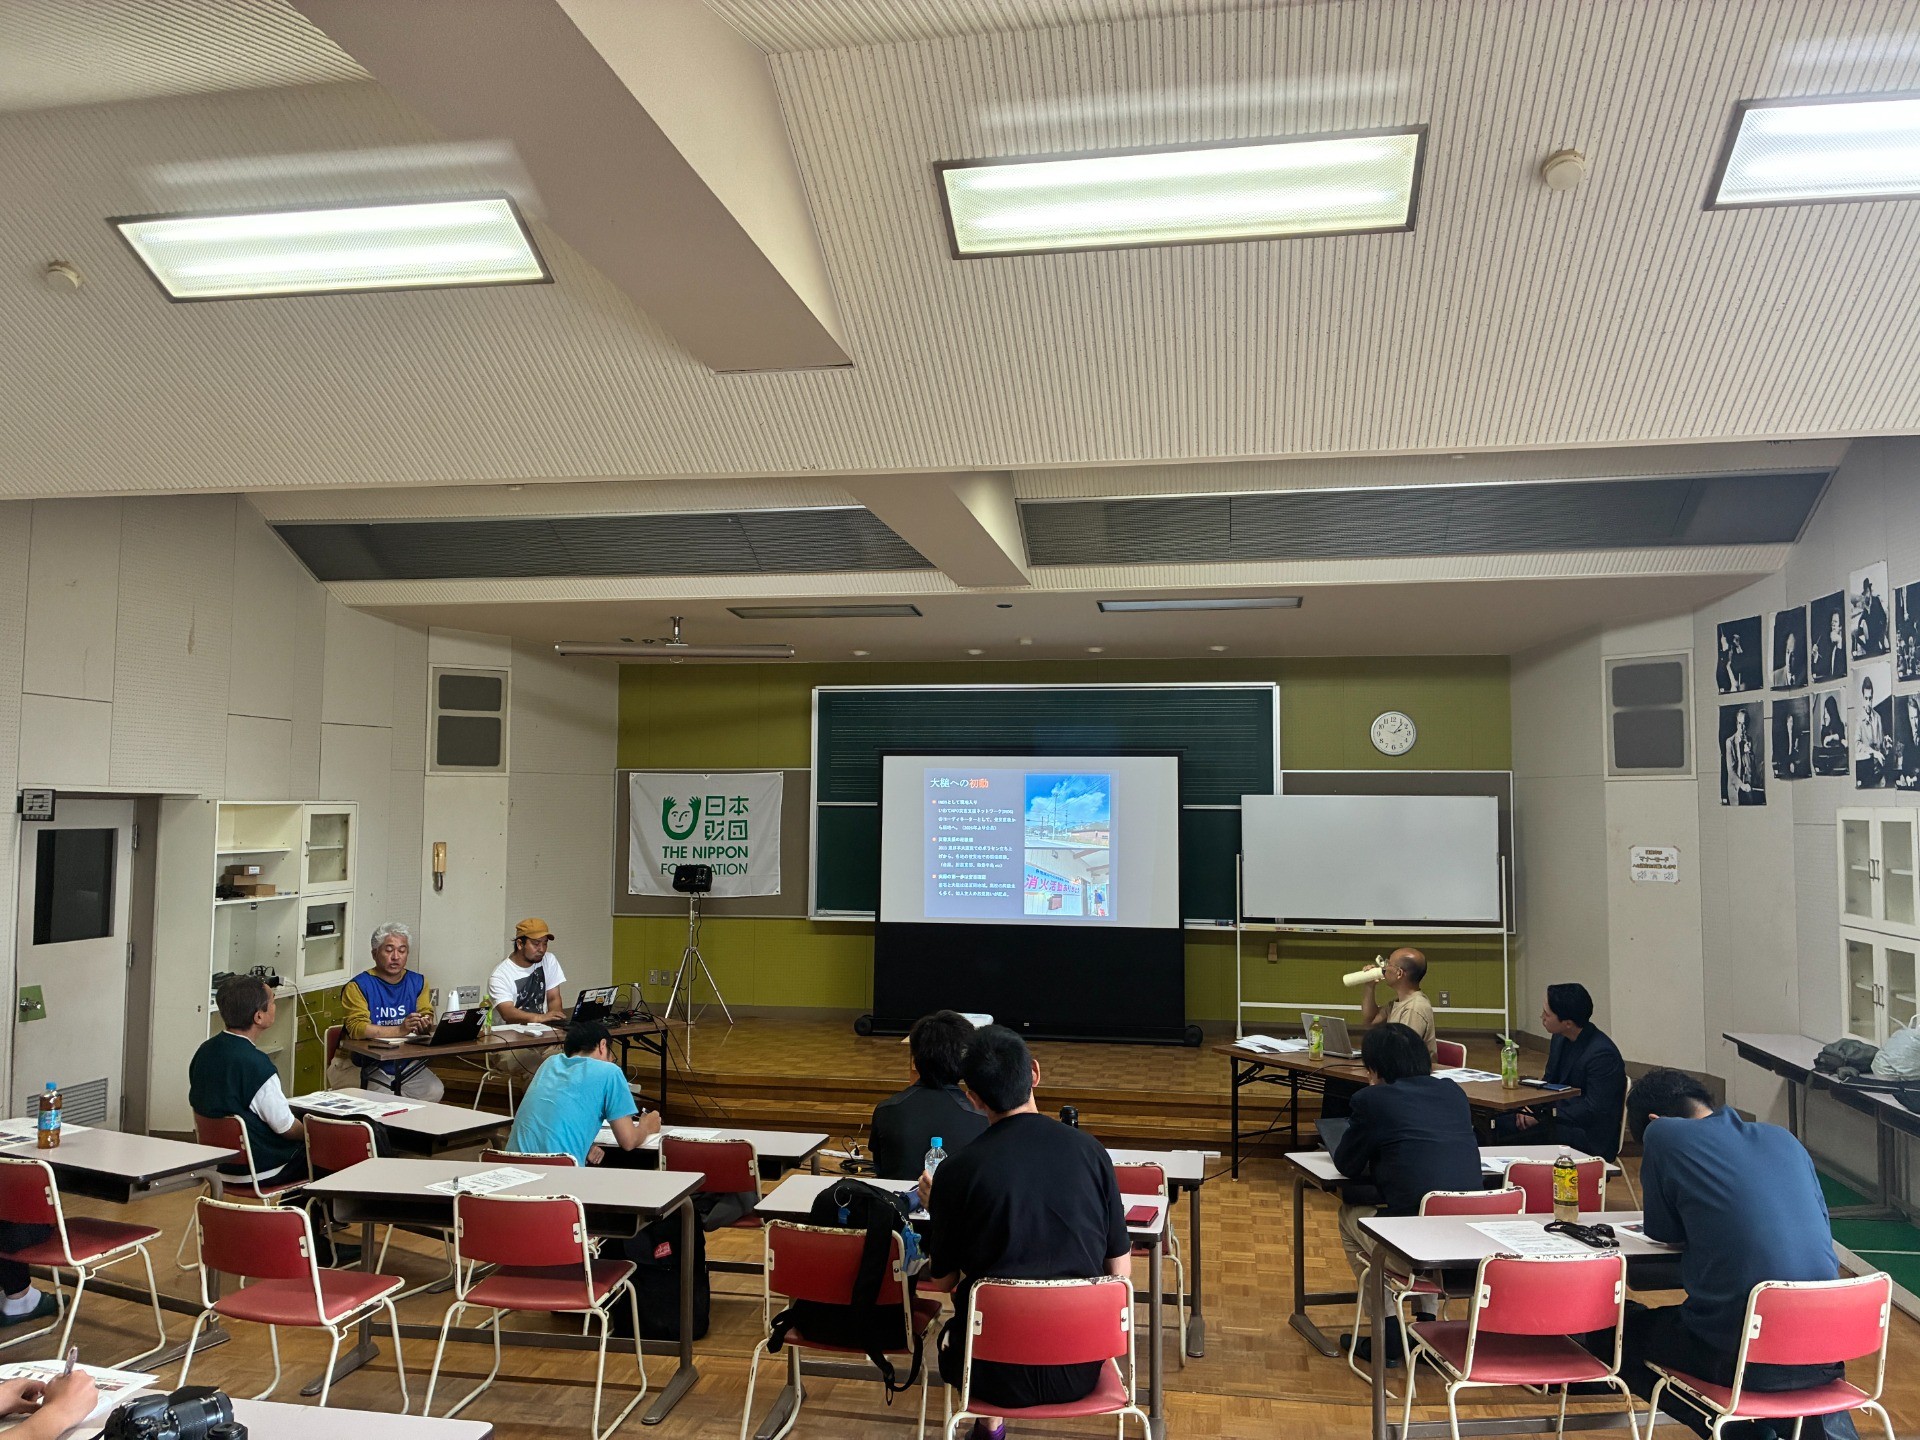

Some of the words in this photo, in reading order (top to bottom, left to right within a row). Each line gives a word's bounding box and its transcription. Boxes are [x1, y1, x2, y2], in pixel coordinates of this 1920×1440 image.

[930, 777, 989, 789] 大槌への初動
[705, 795, 749, 816] 日本
[704, 820, 748, 841] 財団
[662, 845, 688, 859] THE
[692, 845, 749, 859] NIPPON
[660, 862, 748, 876] FOATION
